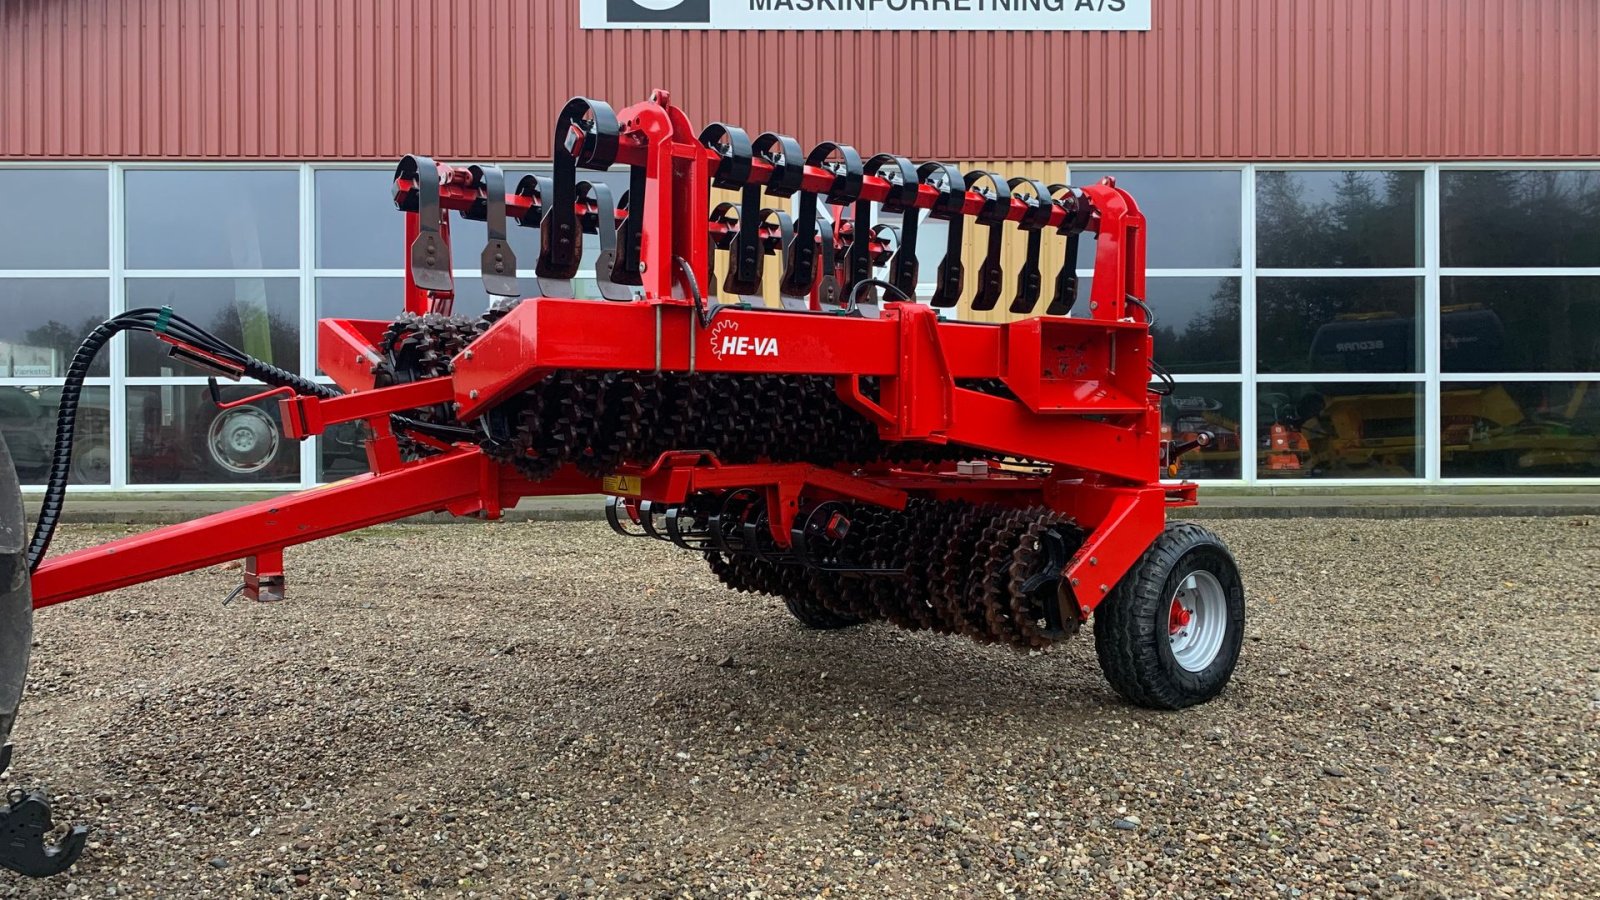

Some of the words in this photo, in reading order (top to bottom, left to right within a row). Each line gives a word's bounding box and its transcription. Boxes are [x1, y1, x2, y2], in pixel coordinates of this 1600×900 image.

[749, 0, 1064, 11] MASKINFORRETNING
[1074, 0, 1126, 12] A/S
[721, 336, 779, 356] HE-VA
